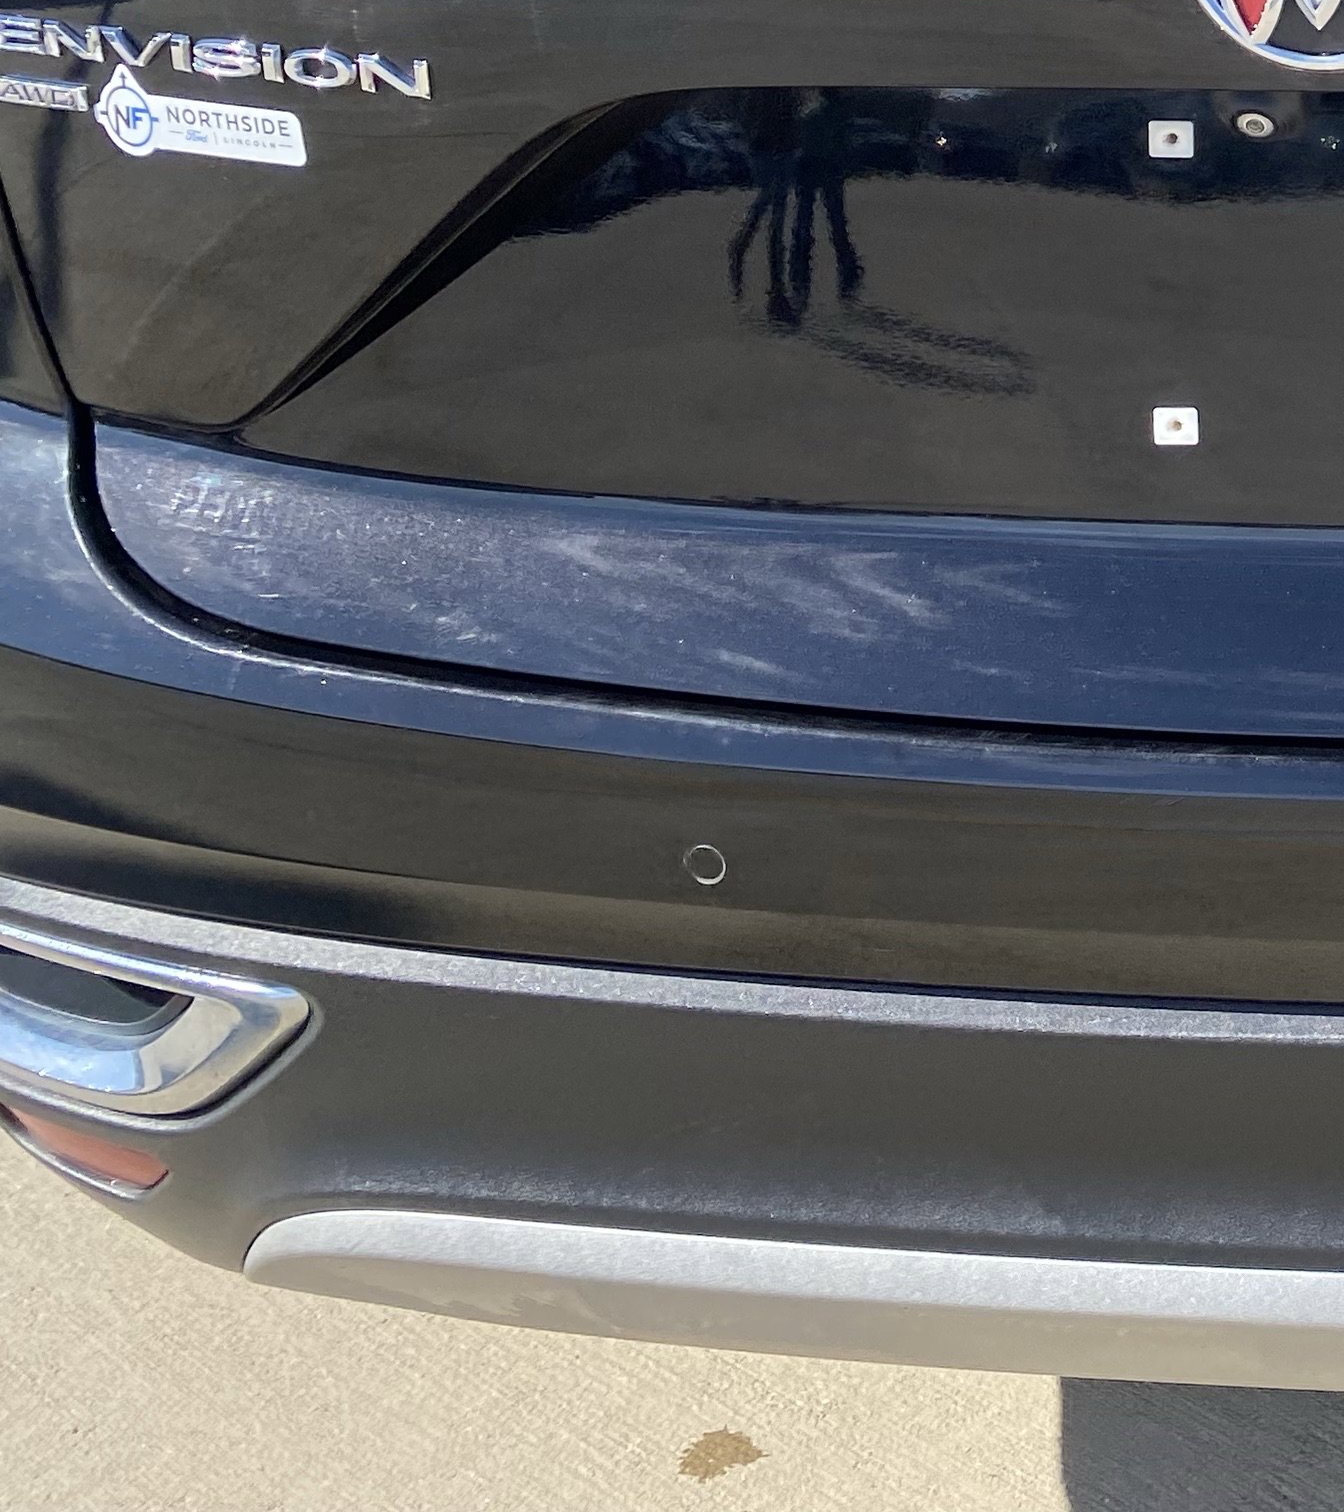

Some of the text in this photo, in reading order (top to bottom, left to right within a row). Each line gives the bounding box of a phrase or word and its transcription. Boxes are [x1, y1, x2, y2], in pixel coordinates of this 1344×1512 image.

[0, 13, 432, 100] ENVISION
[166, 106, 291, 137] NORTHSIDE
[223, 136, 277, 149] LINCOLN
